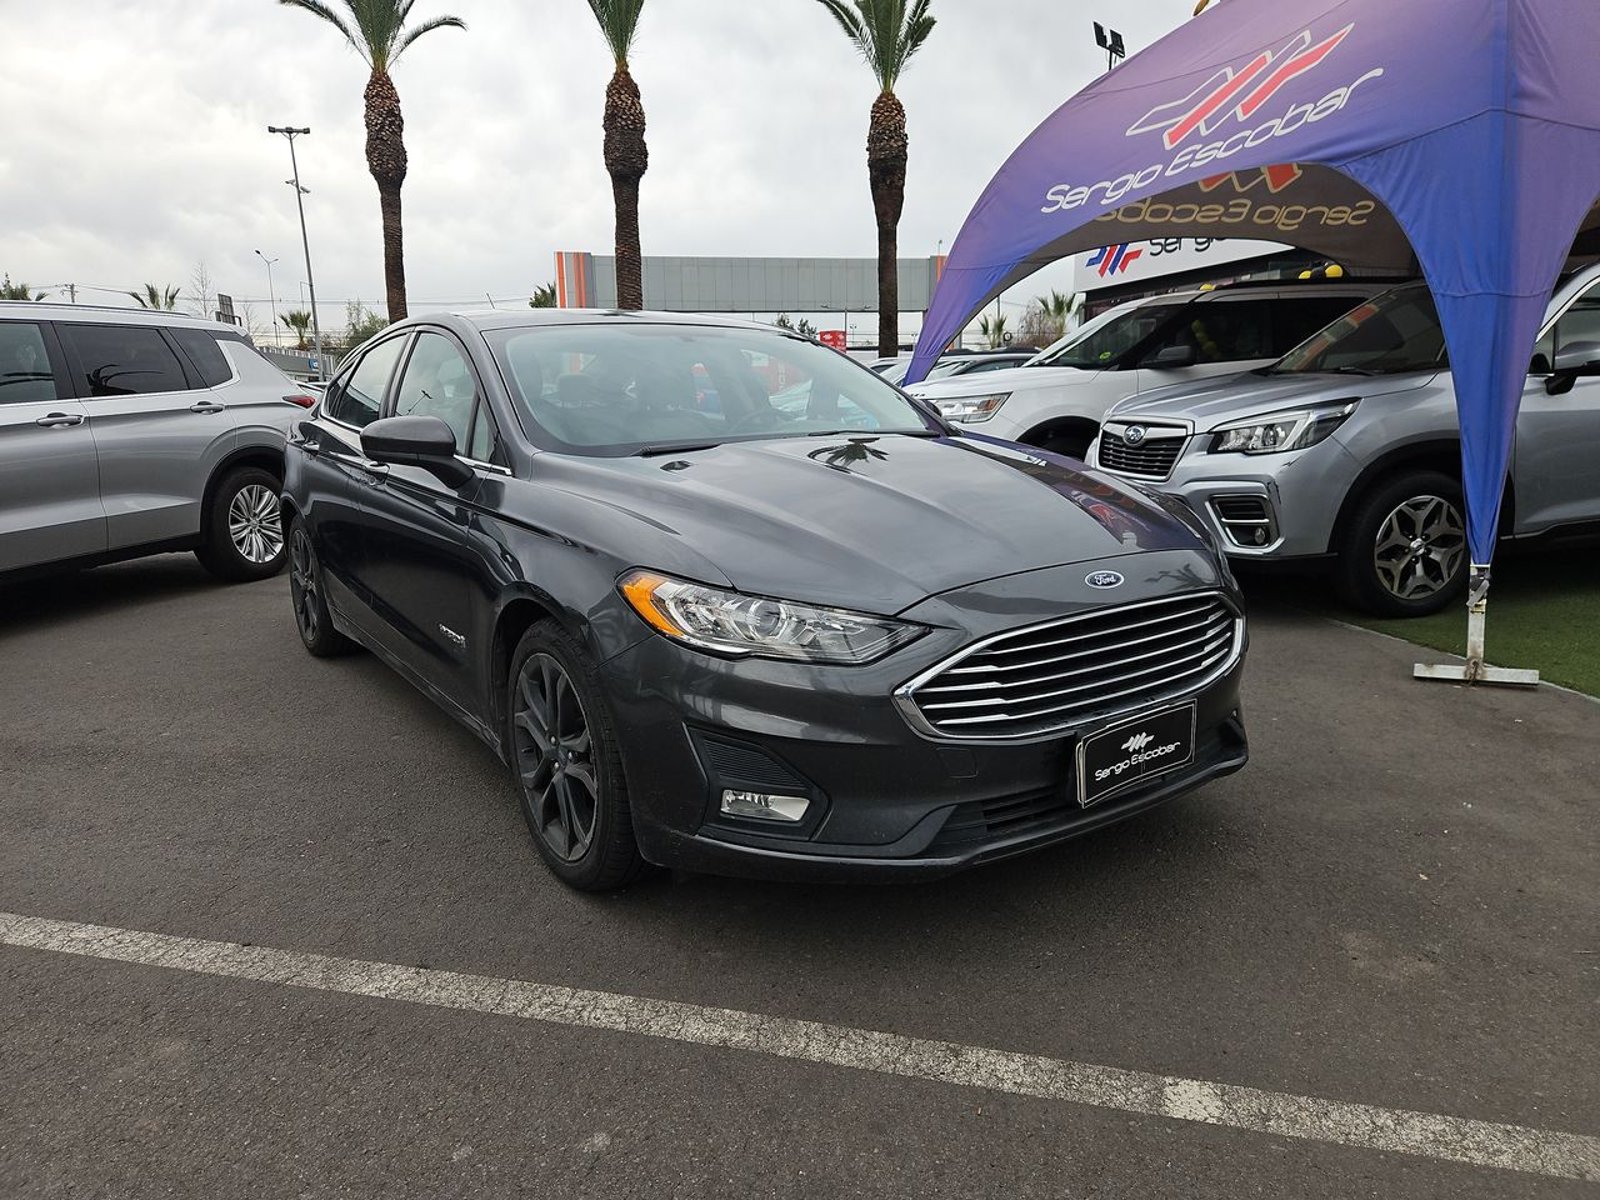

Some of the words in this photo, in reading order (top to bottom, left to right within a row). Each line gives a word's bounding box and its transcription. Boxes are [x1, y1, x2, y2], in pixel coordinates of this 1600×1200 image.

[1041, 164, 1163, 213] Sergio
[1165, 68, 1383, 177] Escobar
[1094, 574, 1117, 586] Ford
[1131, 742, 1181, 765] Escobar
